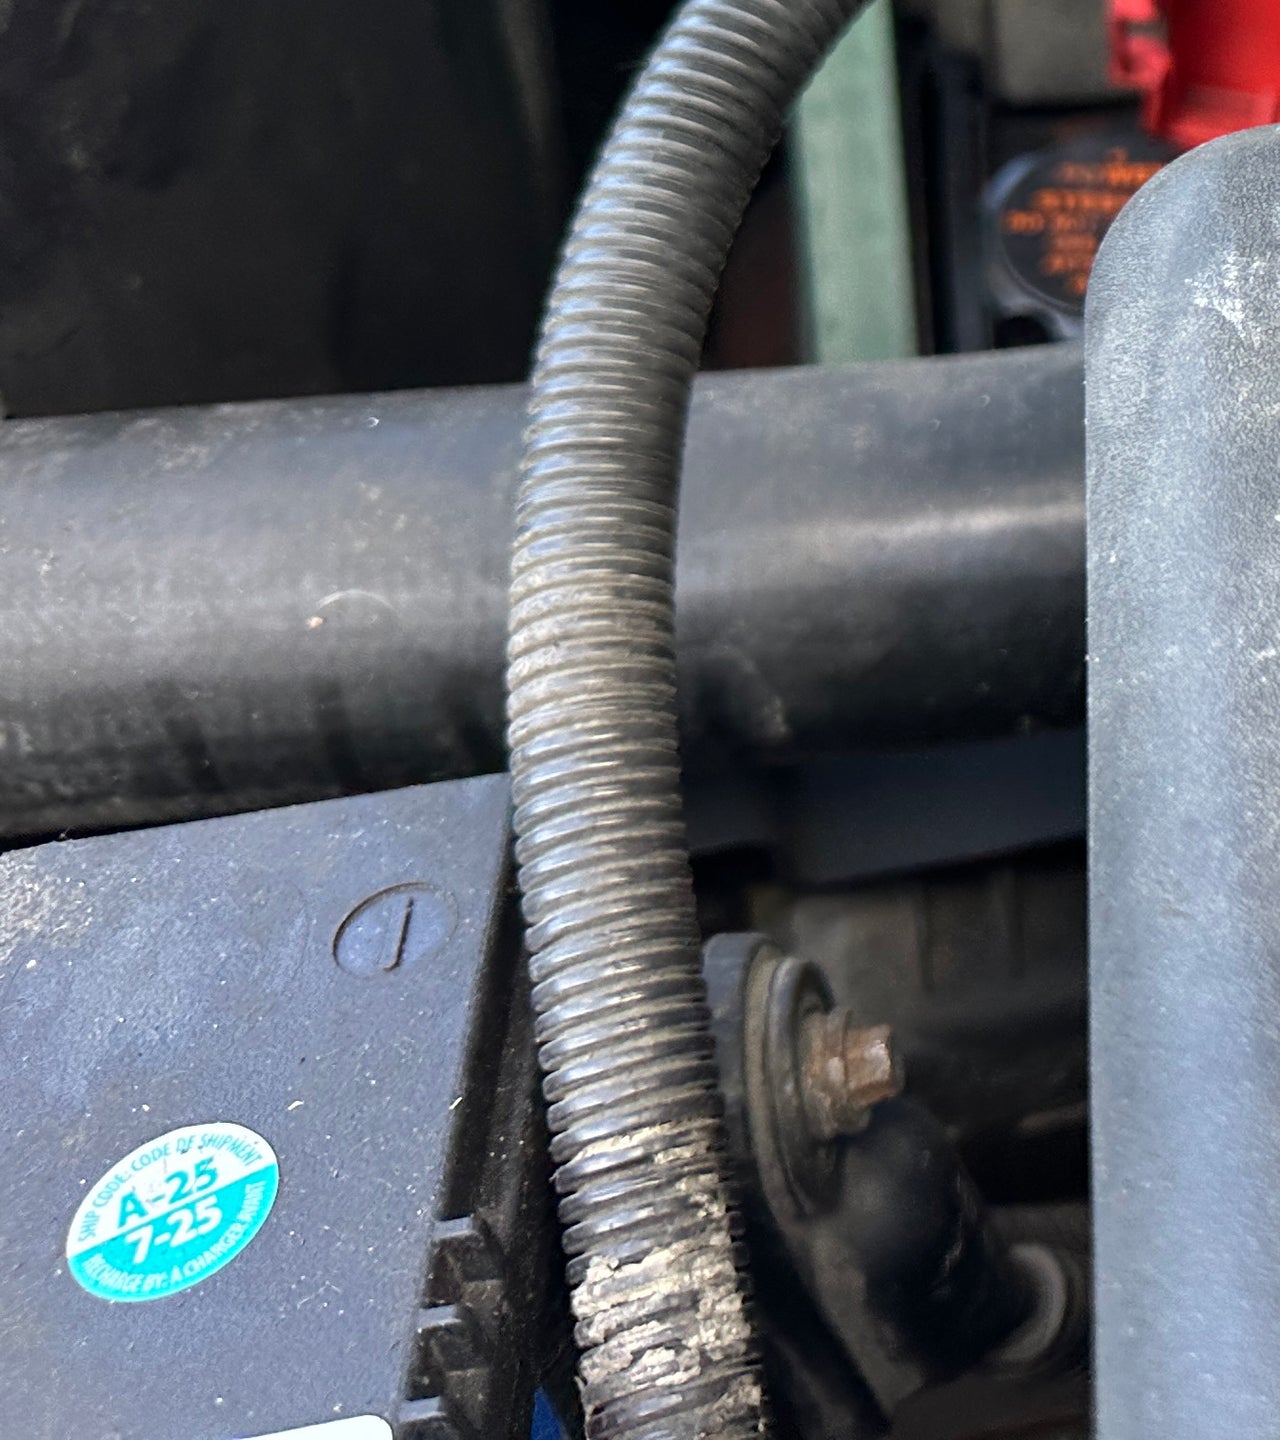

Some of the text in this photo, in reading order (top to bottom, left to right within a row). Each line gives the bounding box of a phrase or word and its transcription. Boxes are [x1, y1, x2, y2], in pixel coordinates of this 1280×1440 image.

[77, 1210, 100, 1242] SHIP
[131, 1142, 171, 1171] CODE
[200, 1132, 264, 1167] SHIPMENT
[117, 1155, 219, 1230] A-25
[123, 1193, 224, 1265] 7-25
[182, 1221, 249, 1277] CHARGER
